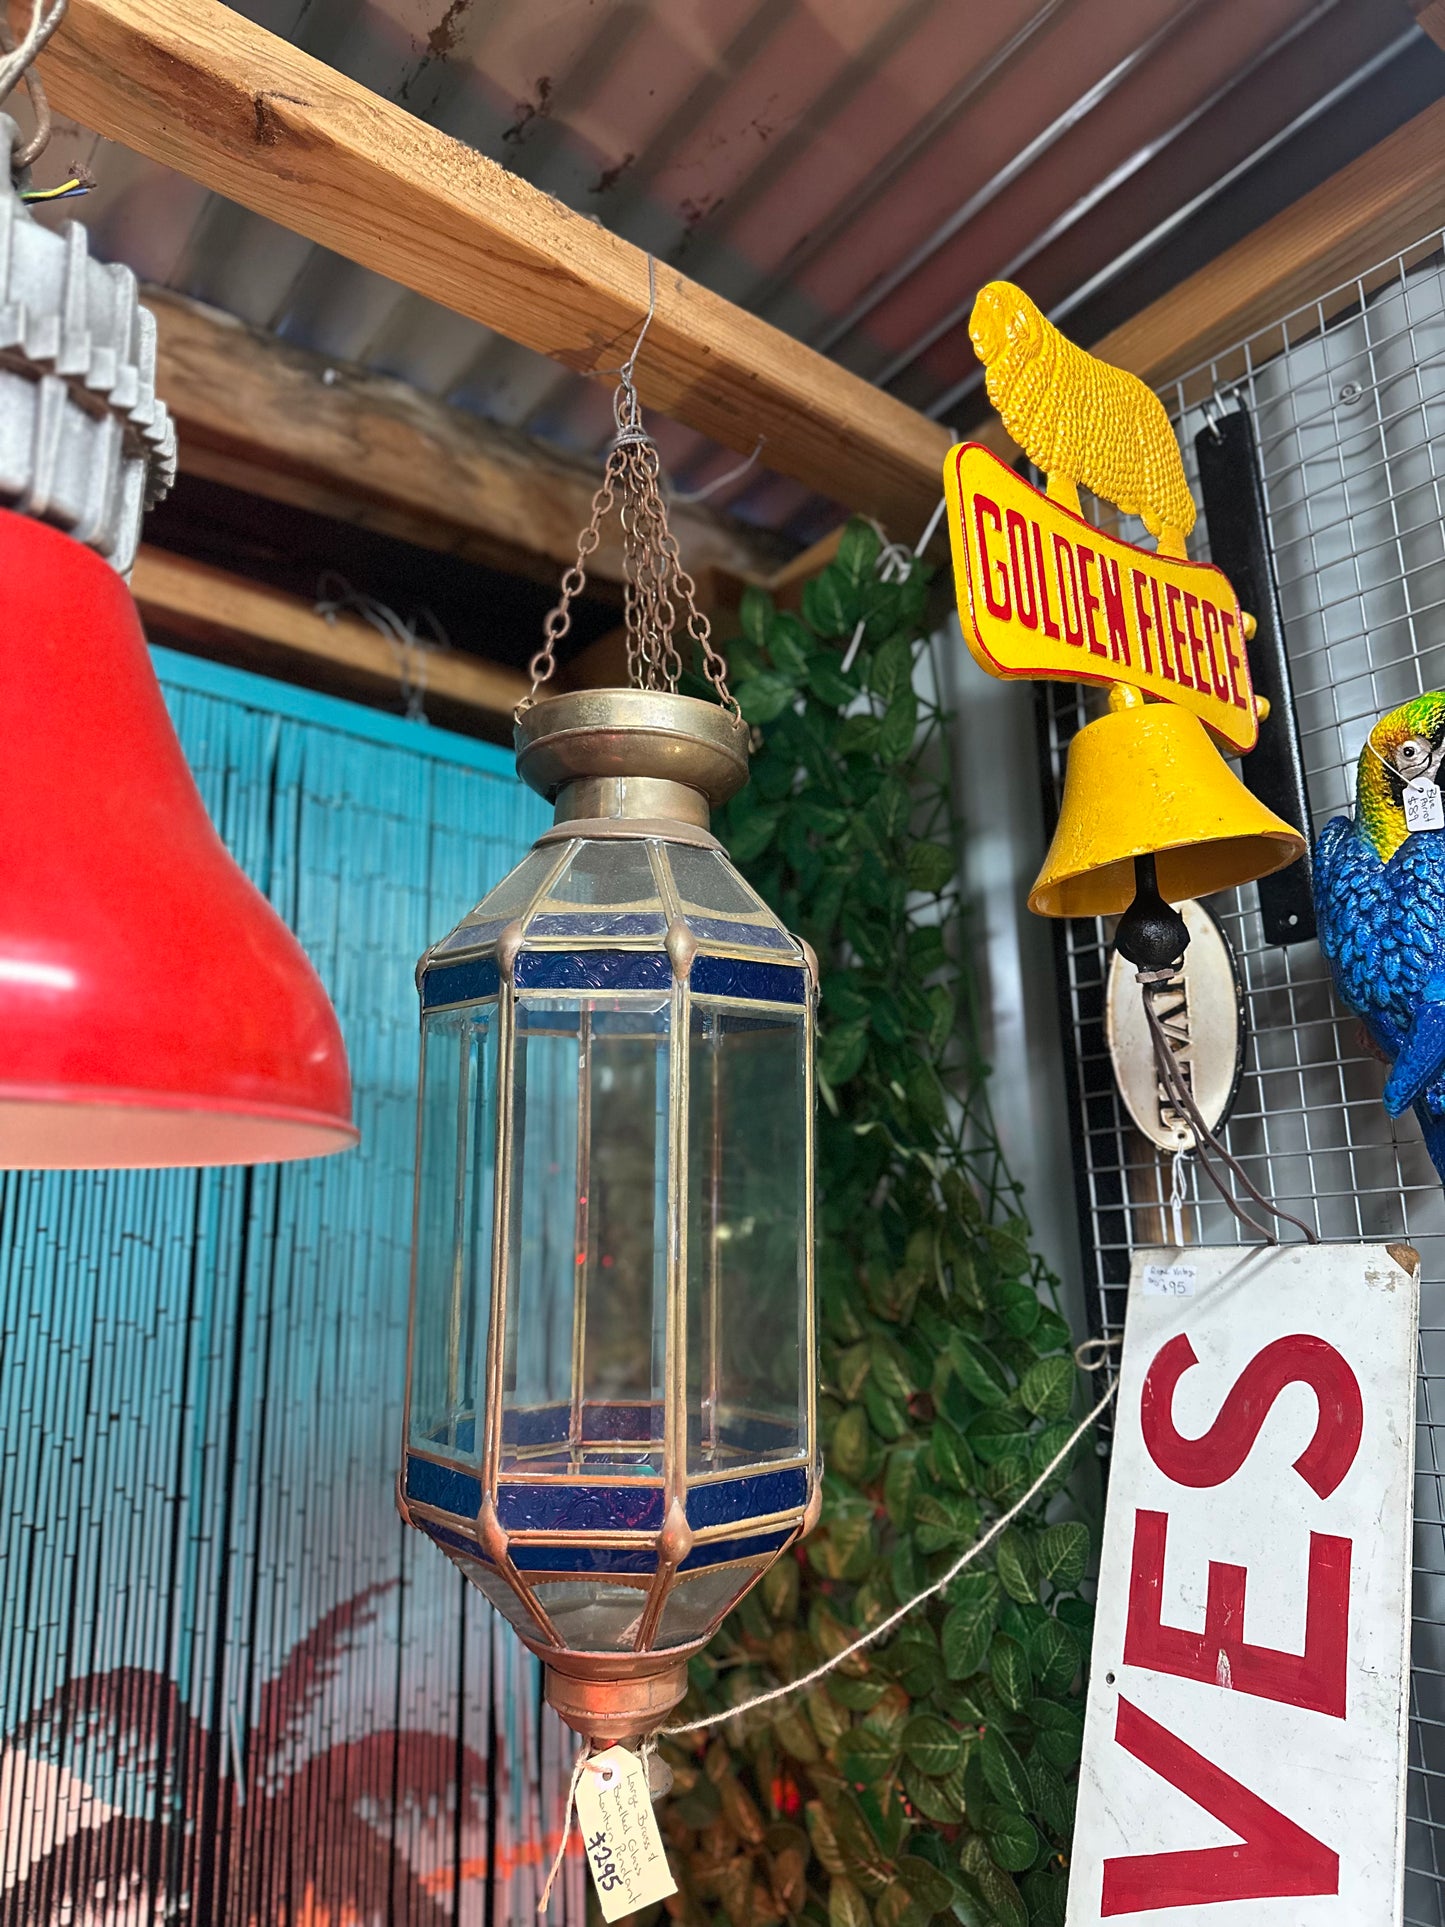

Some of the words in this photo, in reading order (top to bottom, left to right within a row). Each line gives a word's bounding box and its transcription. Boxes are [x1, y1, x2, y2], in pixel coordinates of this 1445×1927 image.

[973, 493, 1132, 667] GOLDEN
[1129, 567, 1247, 710] FLEECE
[1420, 797, 1435, 822] Parrot
[1427, 787, 1437, 809] Blue
[1101, 1332, 1364, 1918] VES
[588, 1831, 623, 1892] $295
